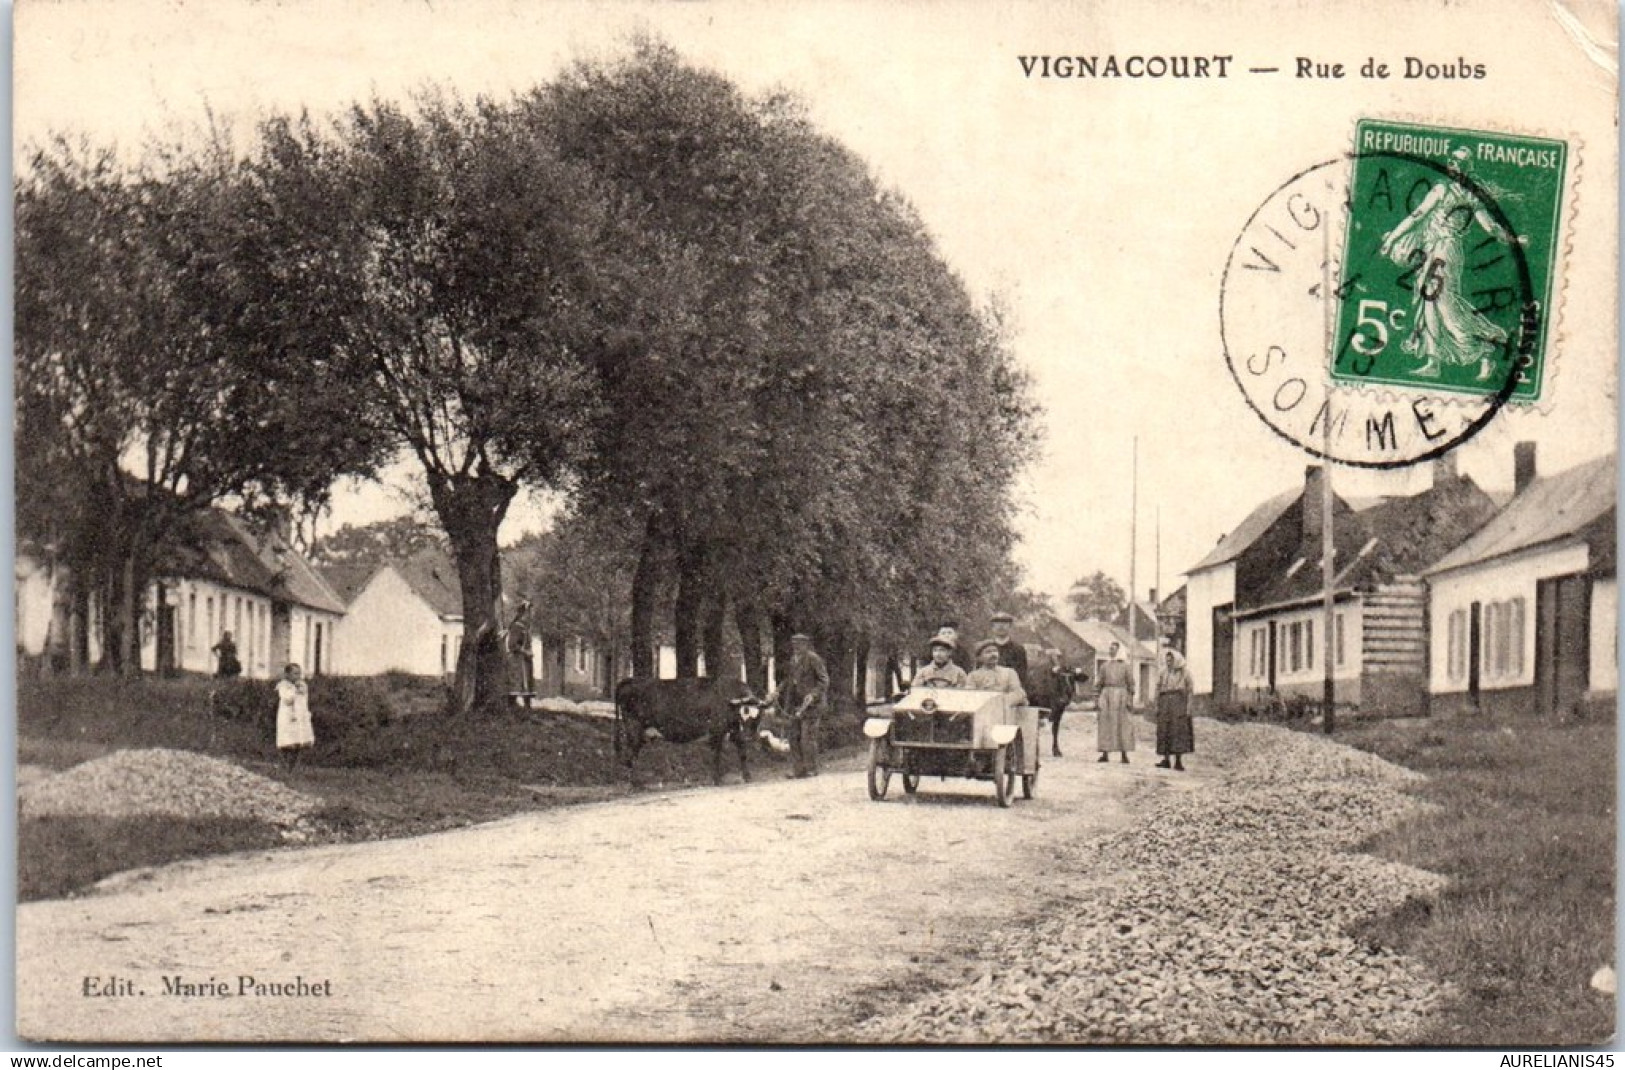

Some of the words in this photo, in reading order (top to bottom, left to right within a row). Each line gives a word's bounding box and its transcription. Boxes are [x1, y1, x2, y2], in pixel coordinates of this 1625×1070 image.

[1017, 54, 1233, 79] VIGNACOURT
[1295, 56, 1346, 79] Rue
[1359, 56, 1391, 79] de
[1403, 56, 1487, 80] Doubs
[1477, 142, 1558, 169] FRANÇAISE
[1247, 345, 1447, 451] SOMME
[83, 975, 145, 997] Edit.
[161, 975, 231, 998] Marie
[237, 975, 333, 998] Pauchet
